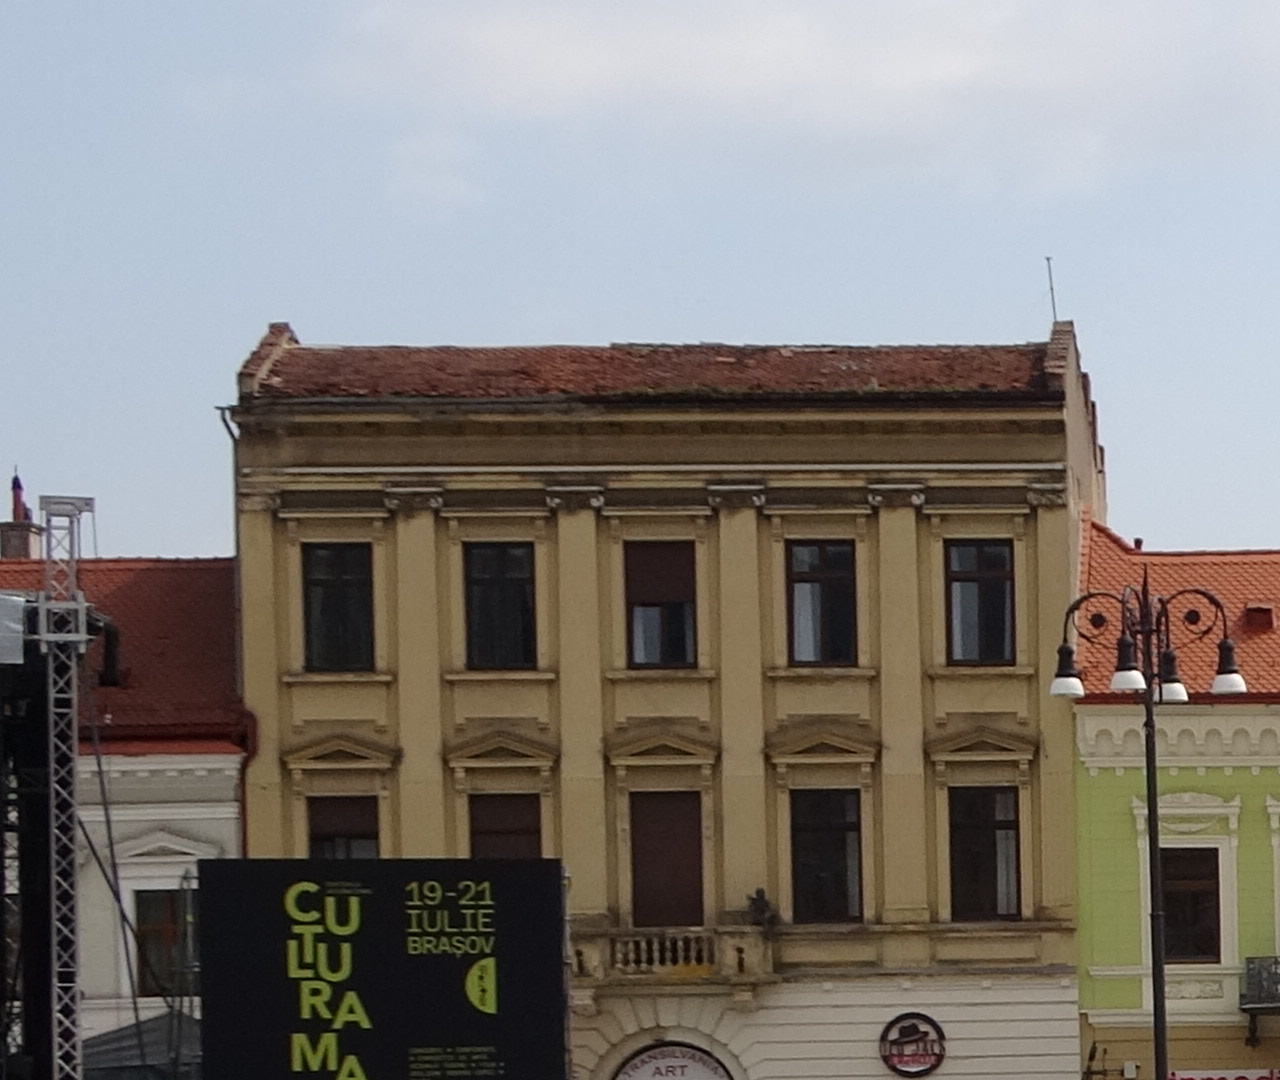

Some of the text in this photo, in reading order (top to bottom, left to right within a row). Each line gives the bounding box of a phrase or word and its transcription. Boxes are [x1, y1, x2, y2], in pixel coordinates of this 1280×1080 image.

[405, 881, 494, 905] 19-21
[406, 909, 495, 932] IULIE
[407, 936, 495, 959] BRAȘOV
[652, 1065, 688, 1077] ART
